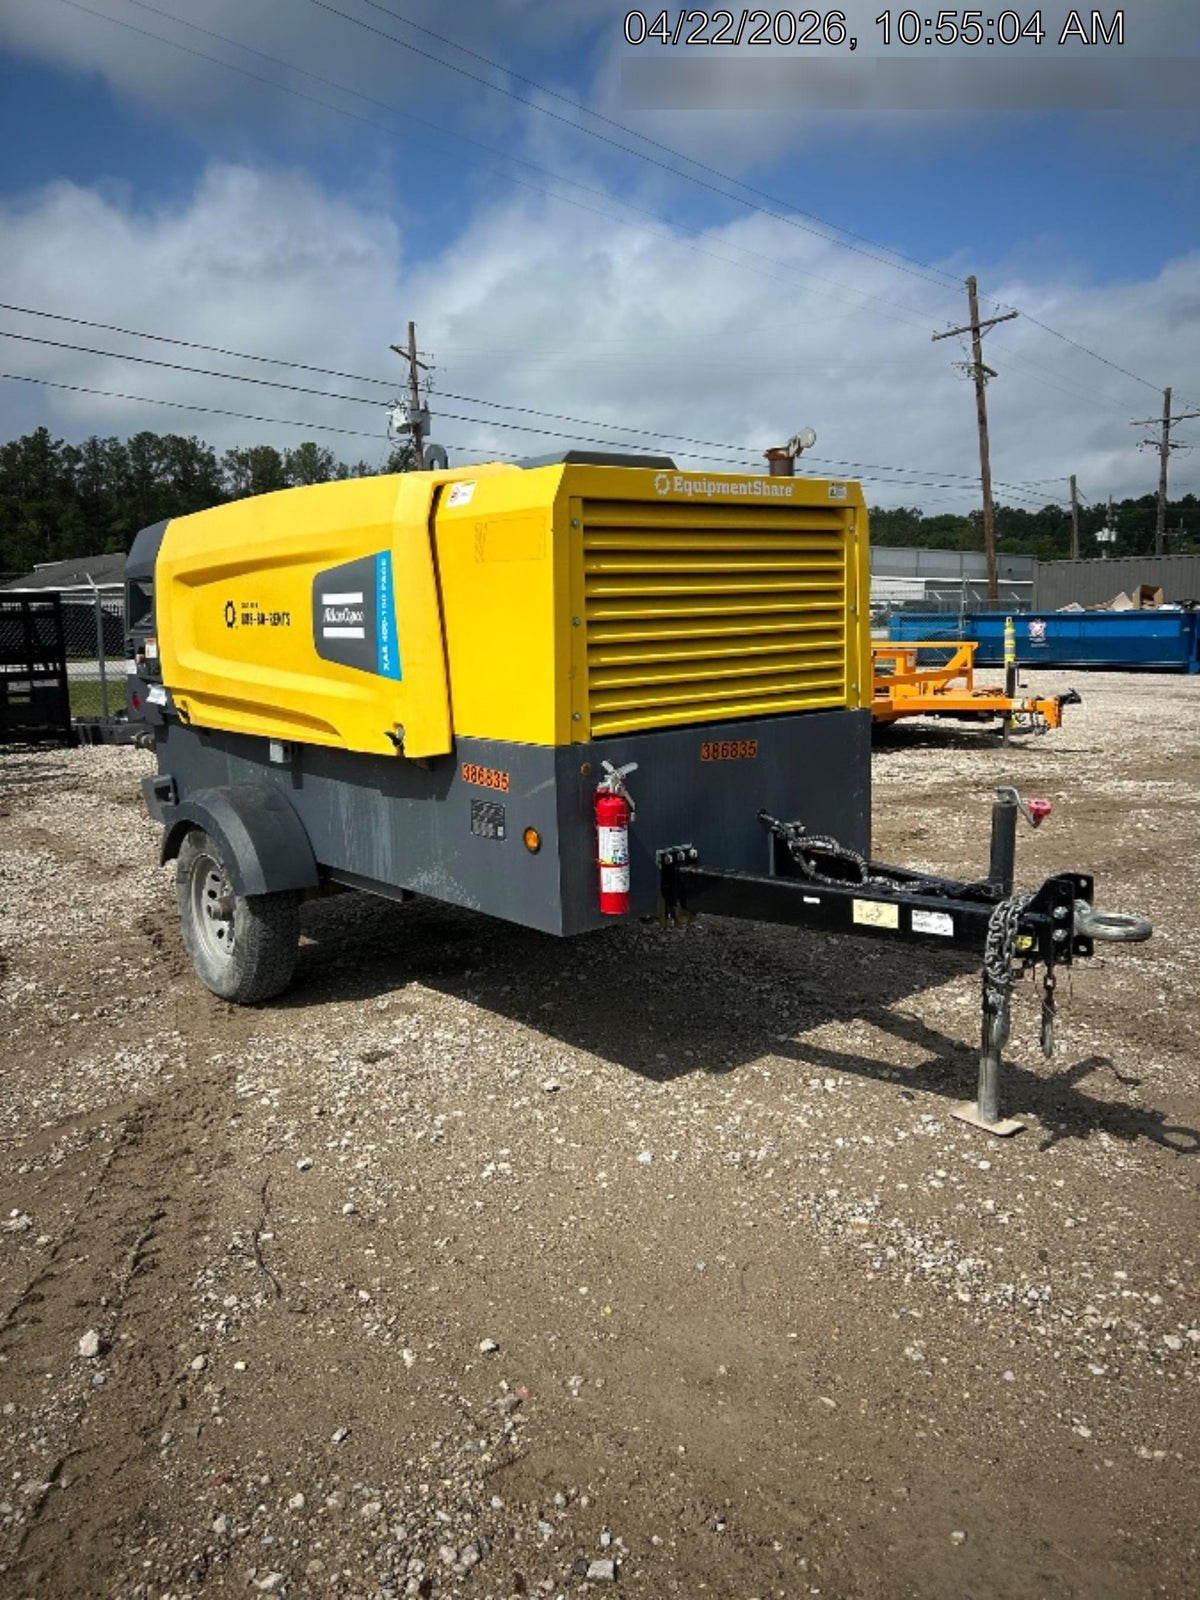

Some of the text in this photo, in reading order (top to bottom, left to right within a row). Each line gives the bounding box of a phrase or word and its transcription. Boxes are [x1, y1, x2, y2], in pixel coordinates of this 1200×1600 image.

[673, 475, 793, 497] EquipmentShare
[701, 741, 757, 760] 386835
[463, 764, 509, 790] 386835
